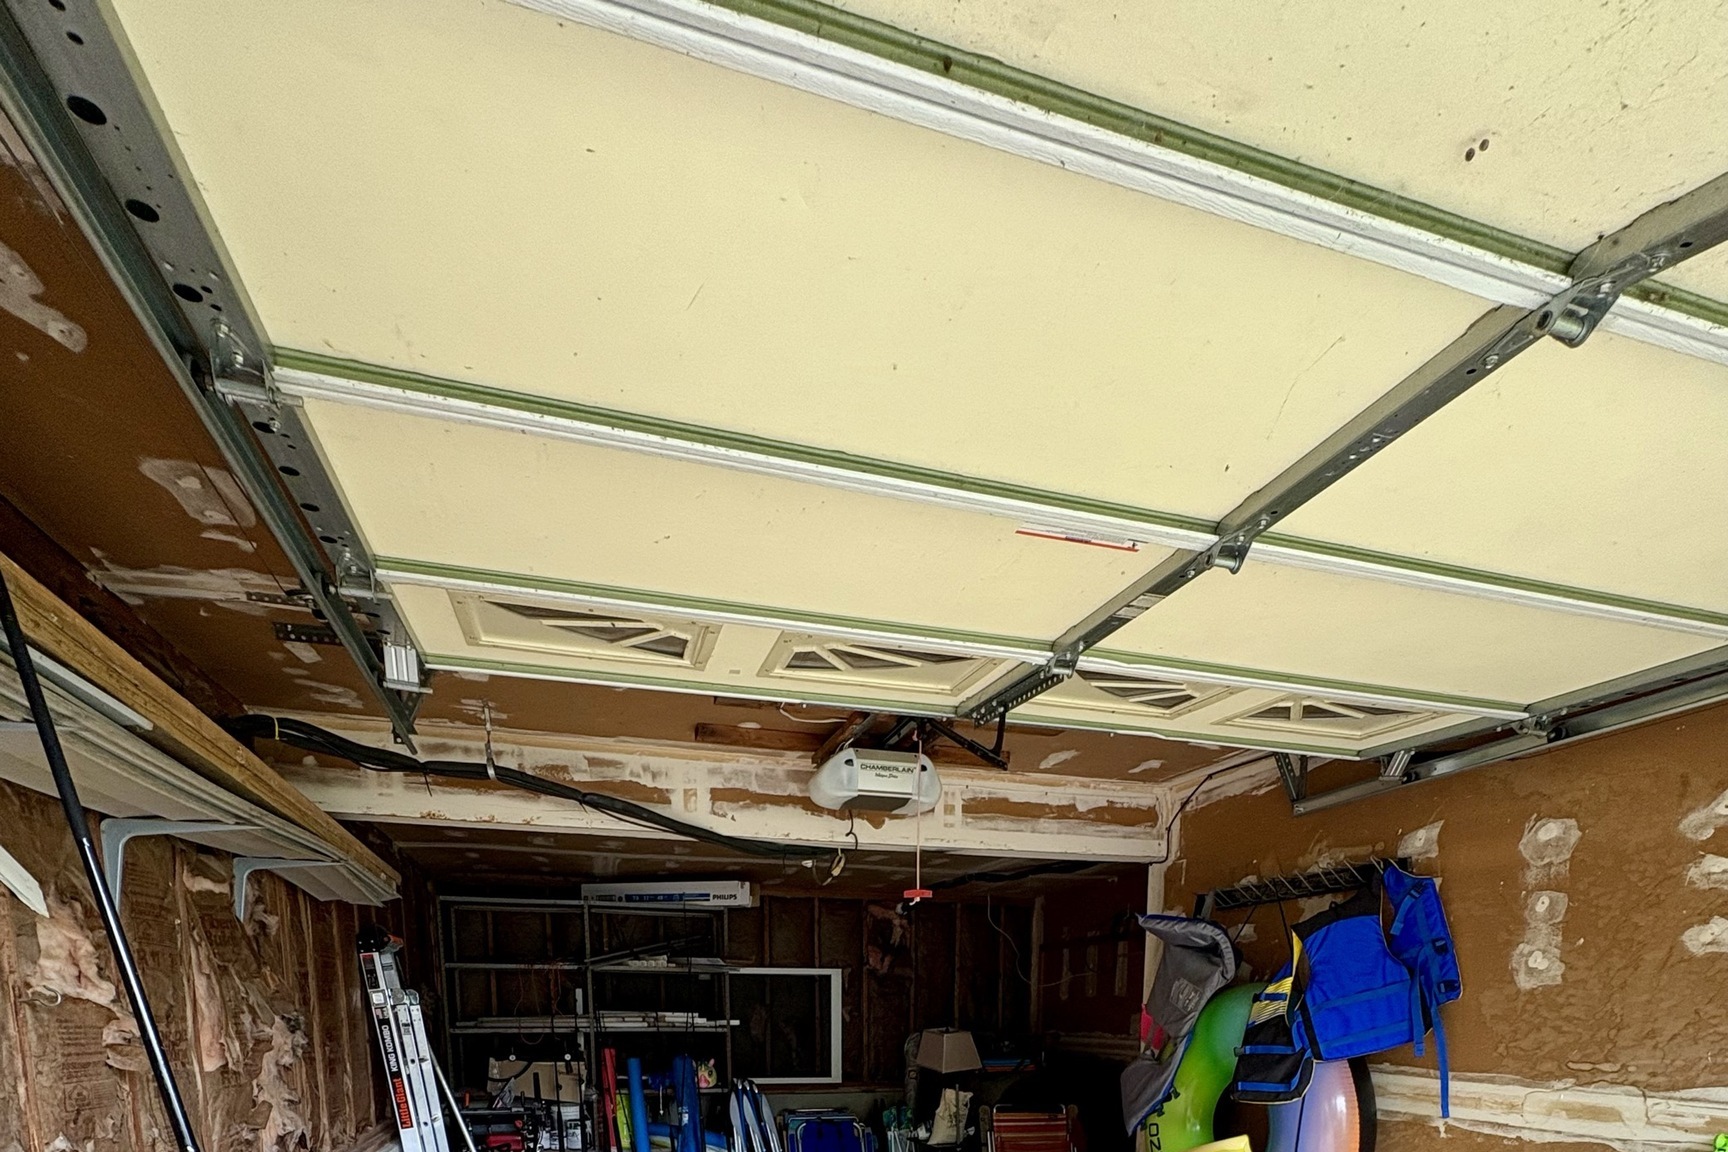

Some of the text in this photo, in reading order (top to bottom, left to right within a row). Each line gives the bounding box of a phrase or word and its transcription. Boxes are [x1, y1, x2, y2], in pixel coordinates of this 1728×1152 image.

[860, 763, 914, 773] CHAMBERLAIN
[712, 893, 738, 901] PHILIPS
[381, 1024, 399, 1072] KING KOMBO
